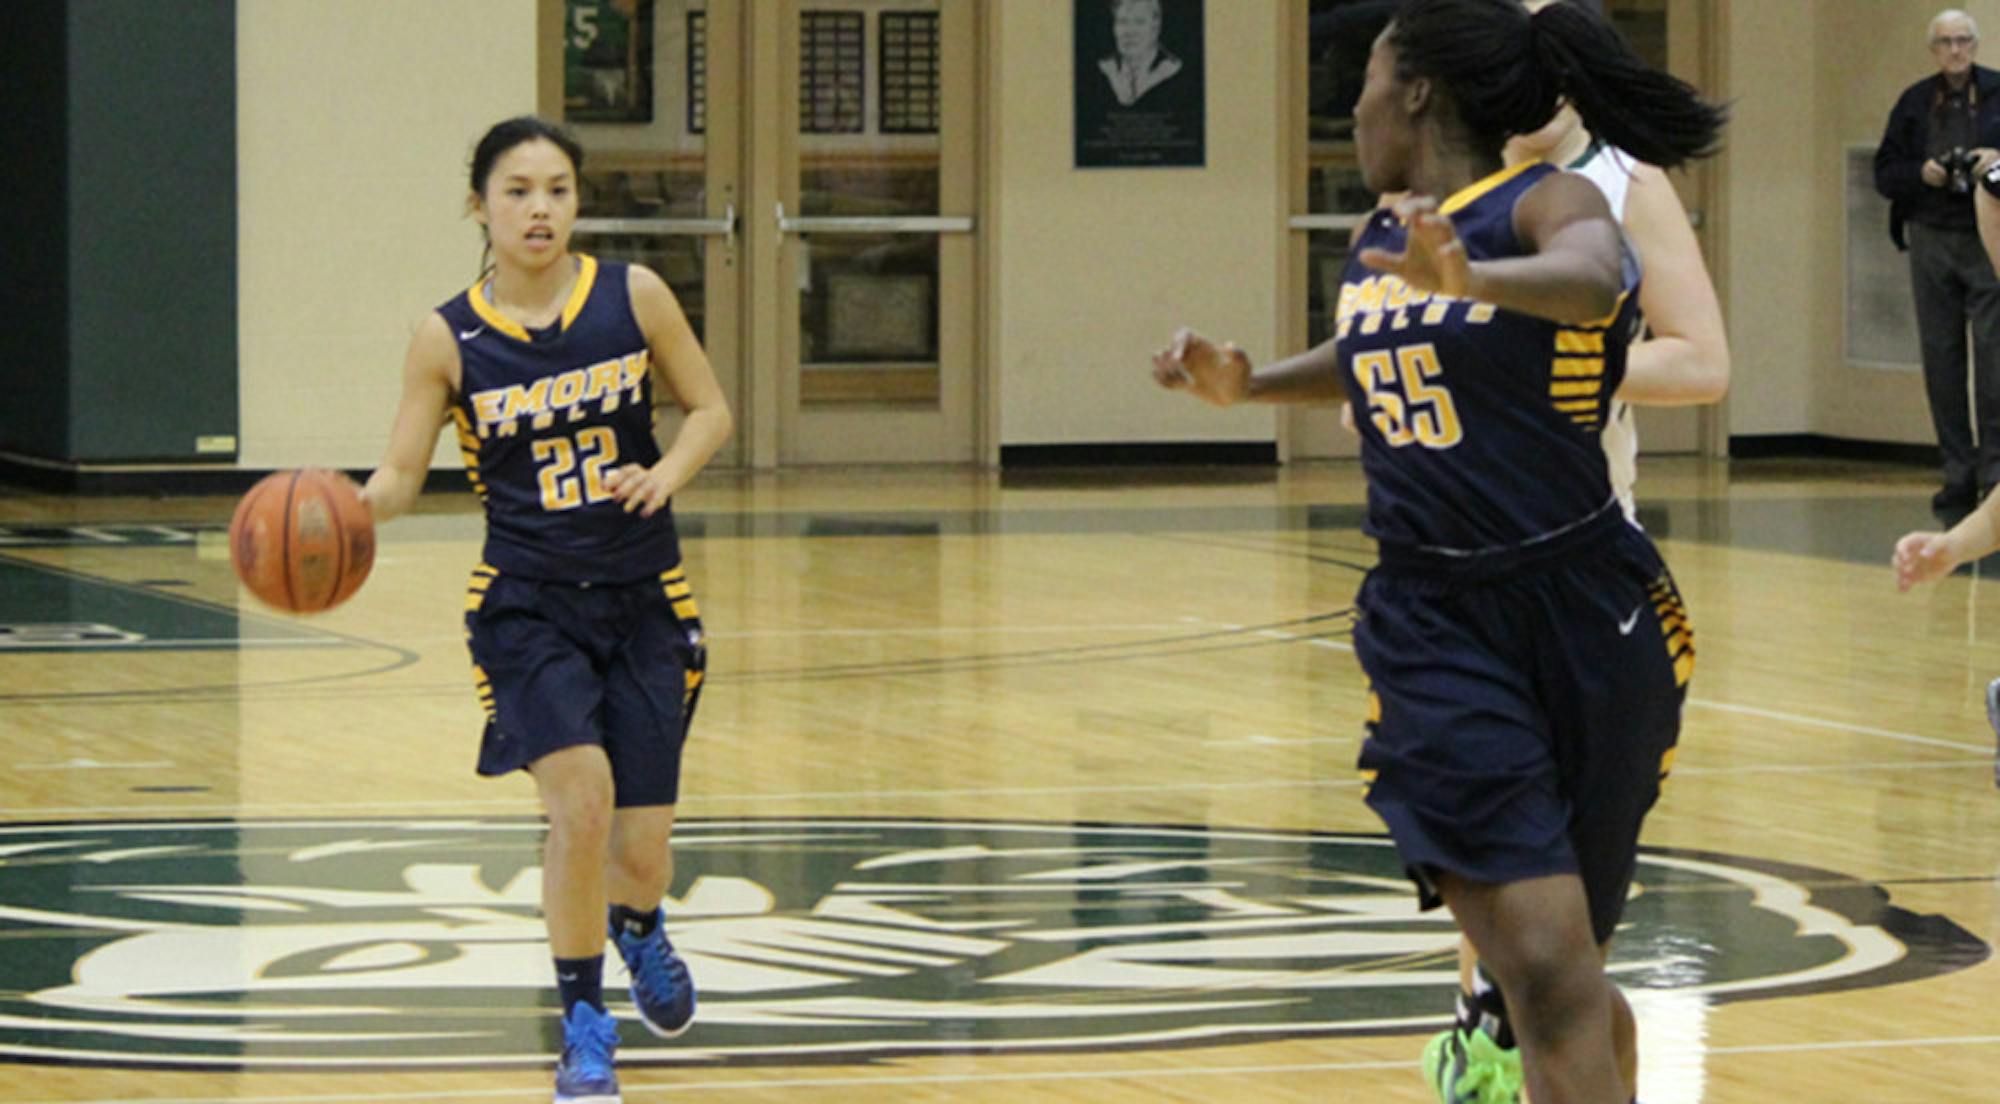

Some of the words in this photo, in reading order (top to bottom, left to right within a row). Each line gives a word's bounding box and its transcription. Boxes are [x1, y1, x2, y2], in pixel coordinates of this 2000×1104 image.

[1336, 274, 1474, 321] EMO
[470, 350, 648, 422] EMORY
[1352, 342, 1463, 448] 55
[531, 427, 620, 510] 22
